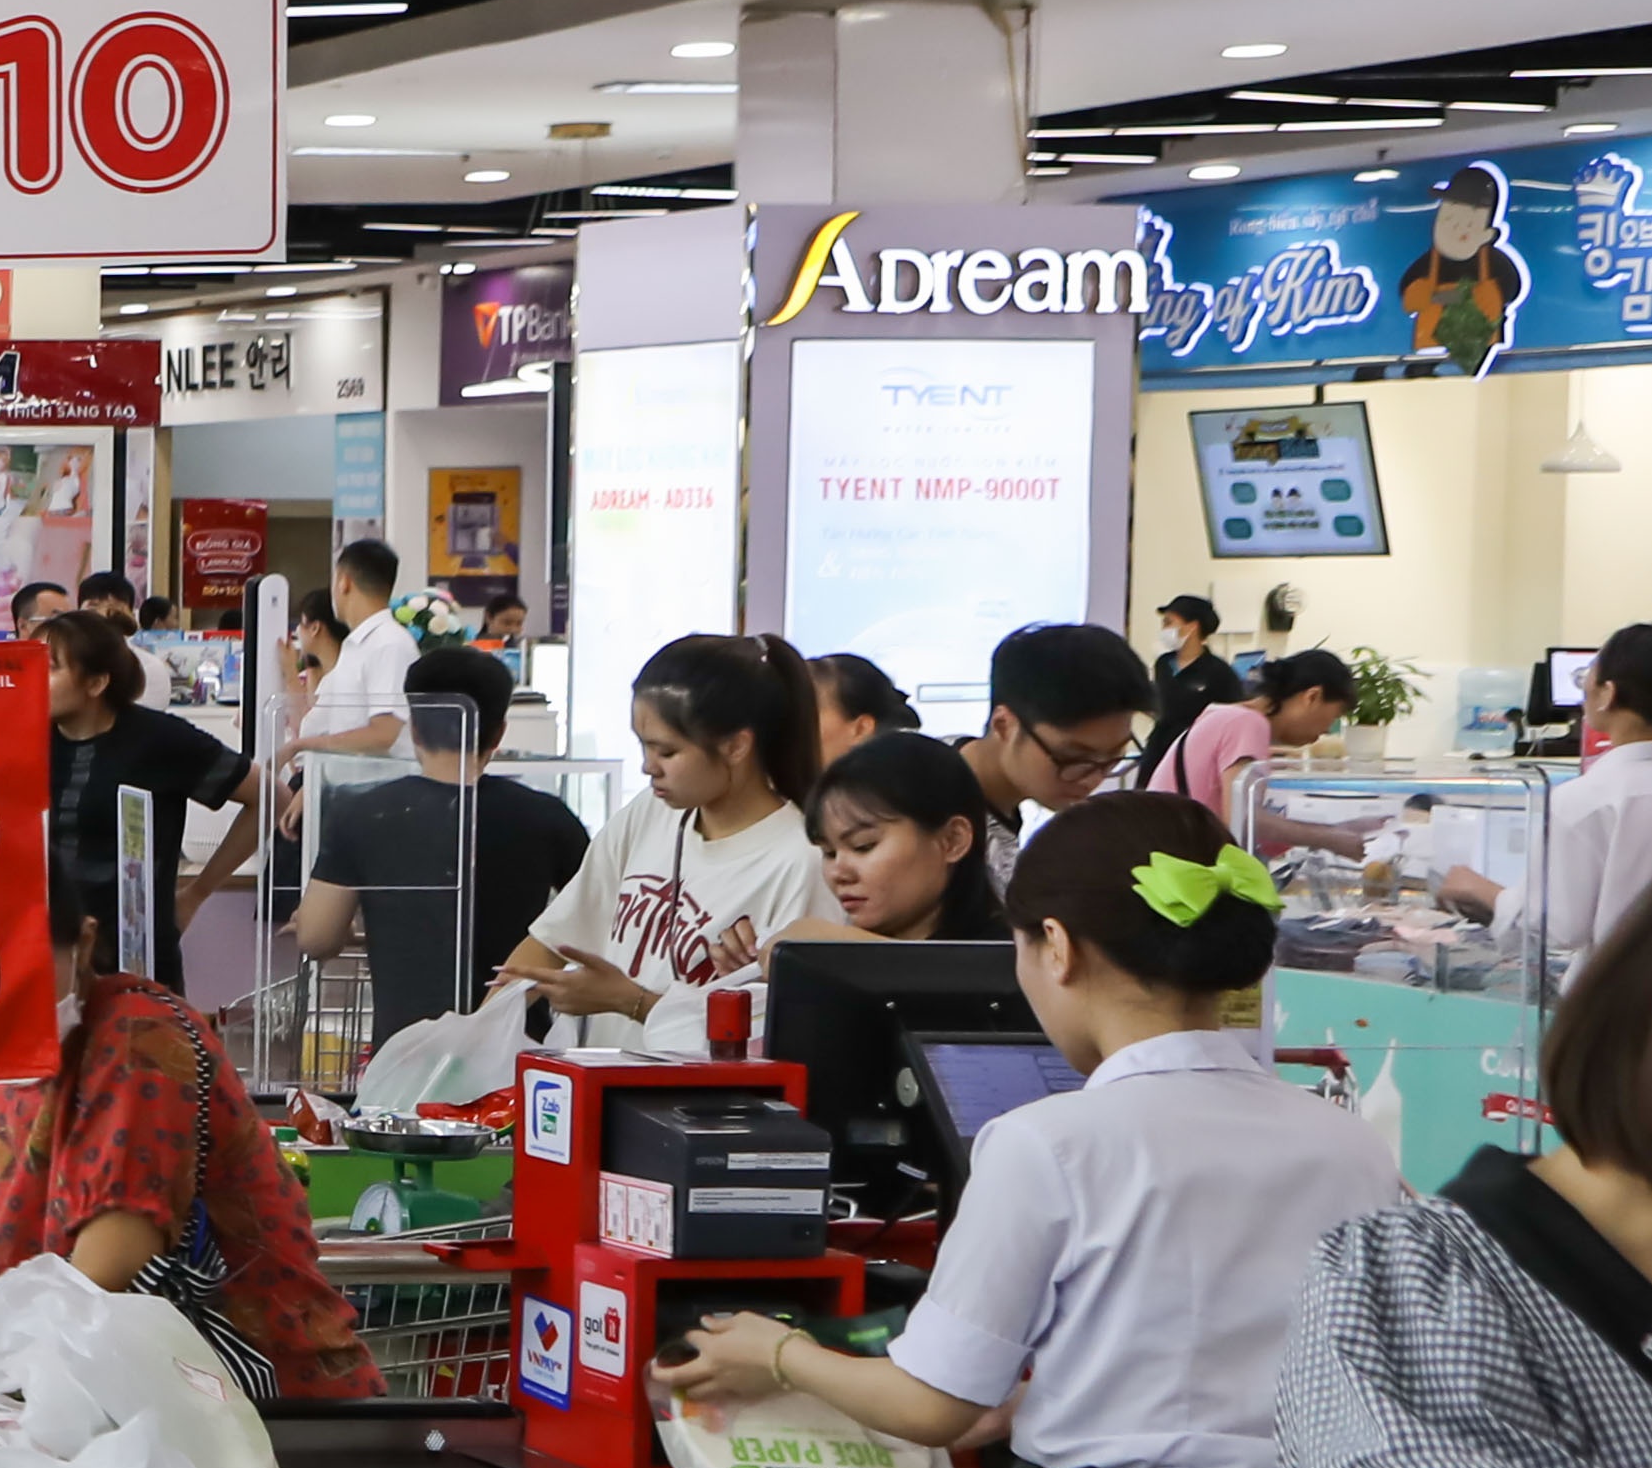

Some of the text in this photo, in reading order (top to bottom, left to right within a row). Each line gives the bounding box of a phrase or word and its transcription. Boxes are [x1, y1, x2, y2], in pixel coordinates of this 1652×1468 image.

[1213, 244, 1369, 342] of Kim
[881, 384, 1013, 407] TYENT
[664, 486, 714, 511] AD336
[818, 477, 1061, 501] TYENT NMP-9000T
[542, 1095, 561, 1115] Zalo
[729, 1435, 823, 1465] PAPER
